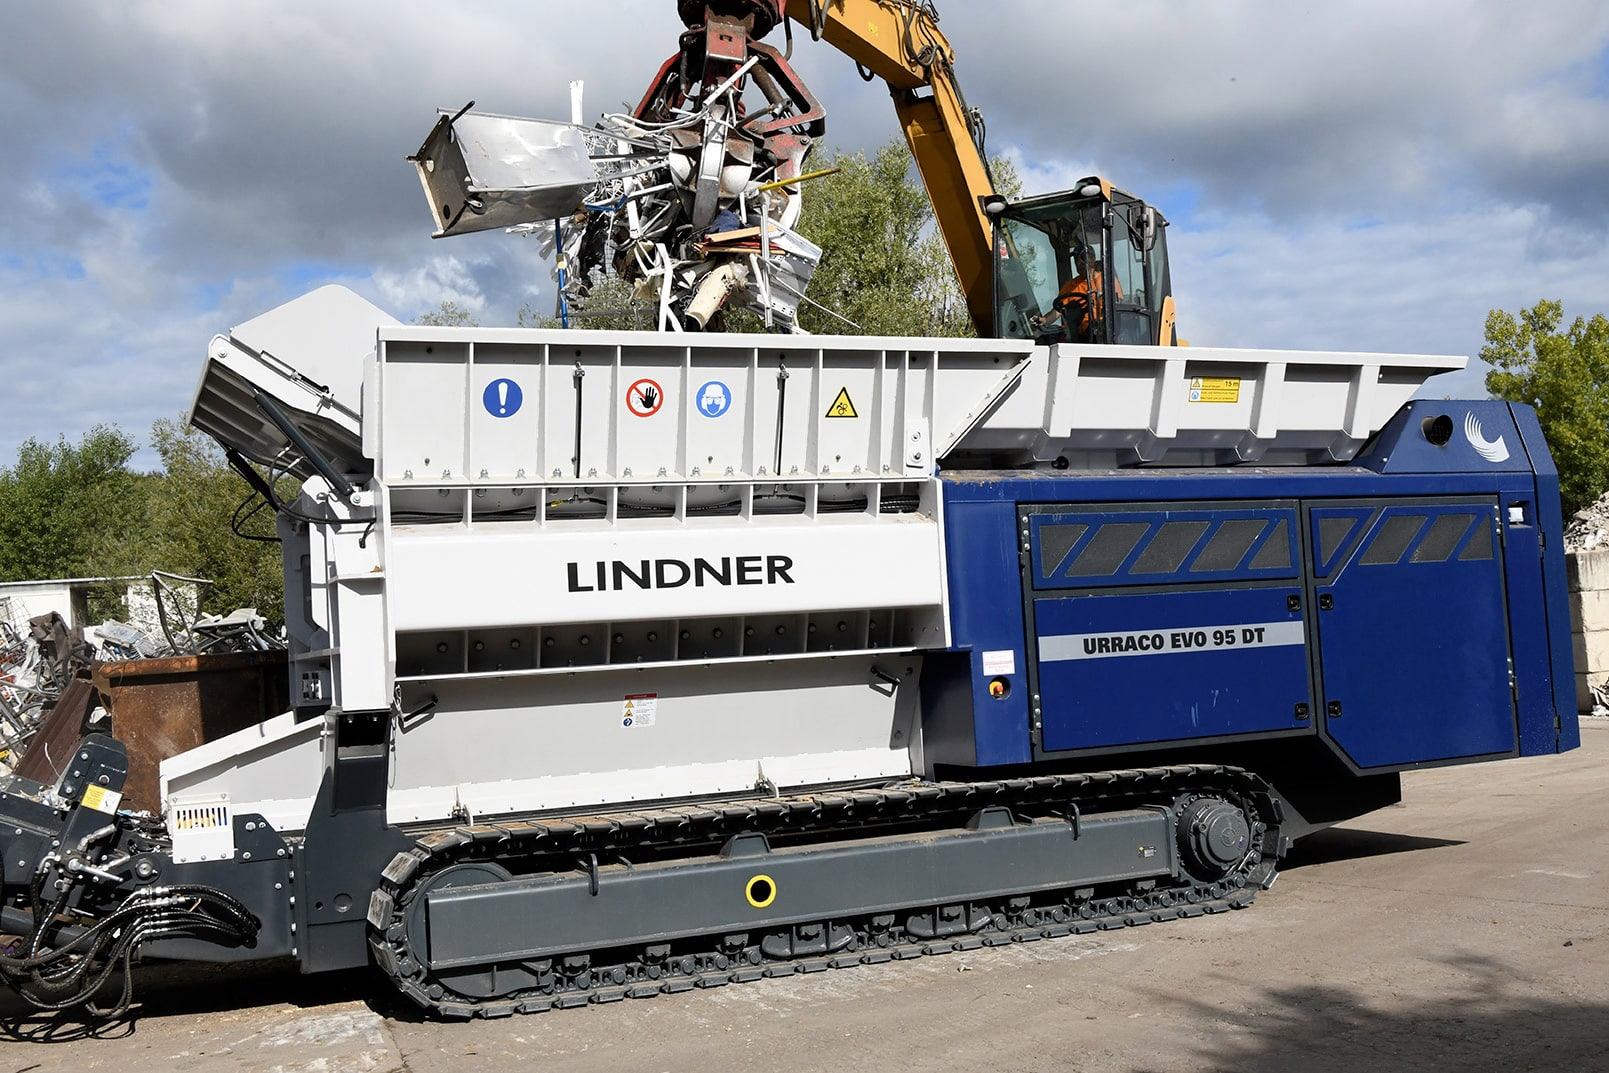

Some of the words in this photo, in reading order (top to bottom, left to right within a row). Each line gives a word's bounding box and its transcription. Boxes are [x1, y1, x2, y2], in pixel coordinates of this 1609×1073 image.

[567, 555, 795, 592] LINDNER
[1083, 634, 1165, 655] URRACO
[1171, 631, 1207, 649] EVO
[1212, 629, 1236, 646] 95
[1242, 627, 1266, 644] DT
